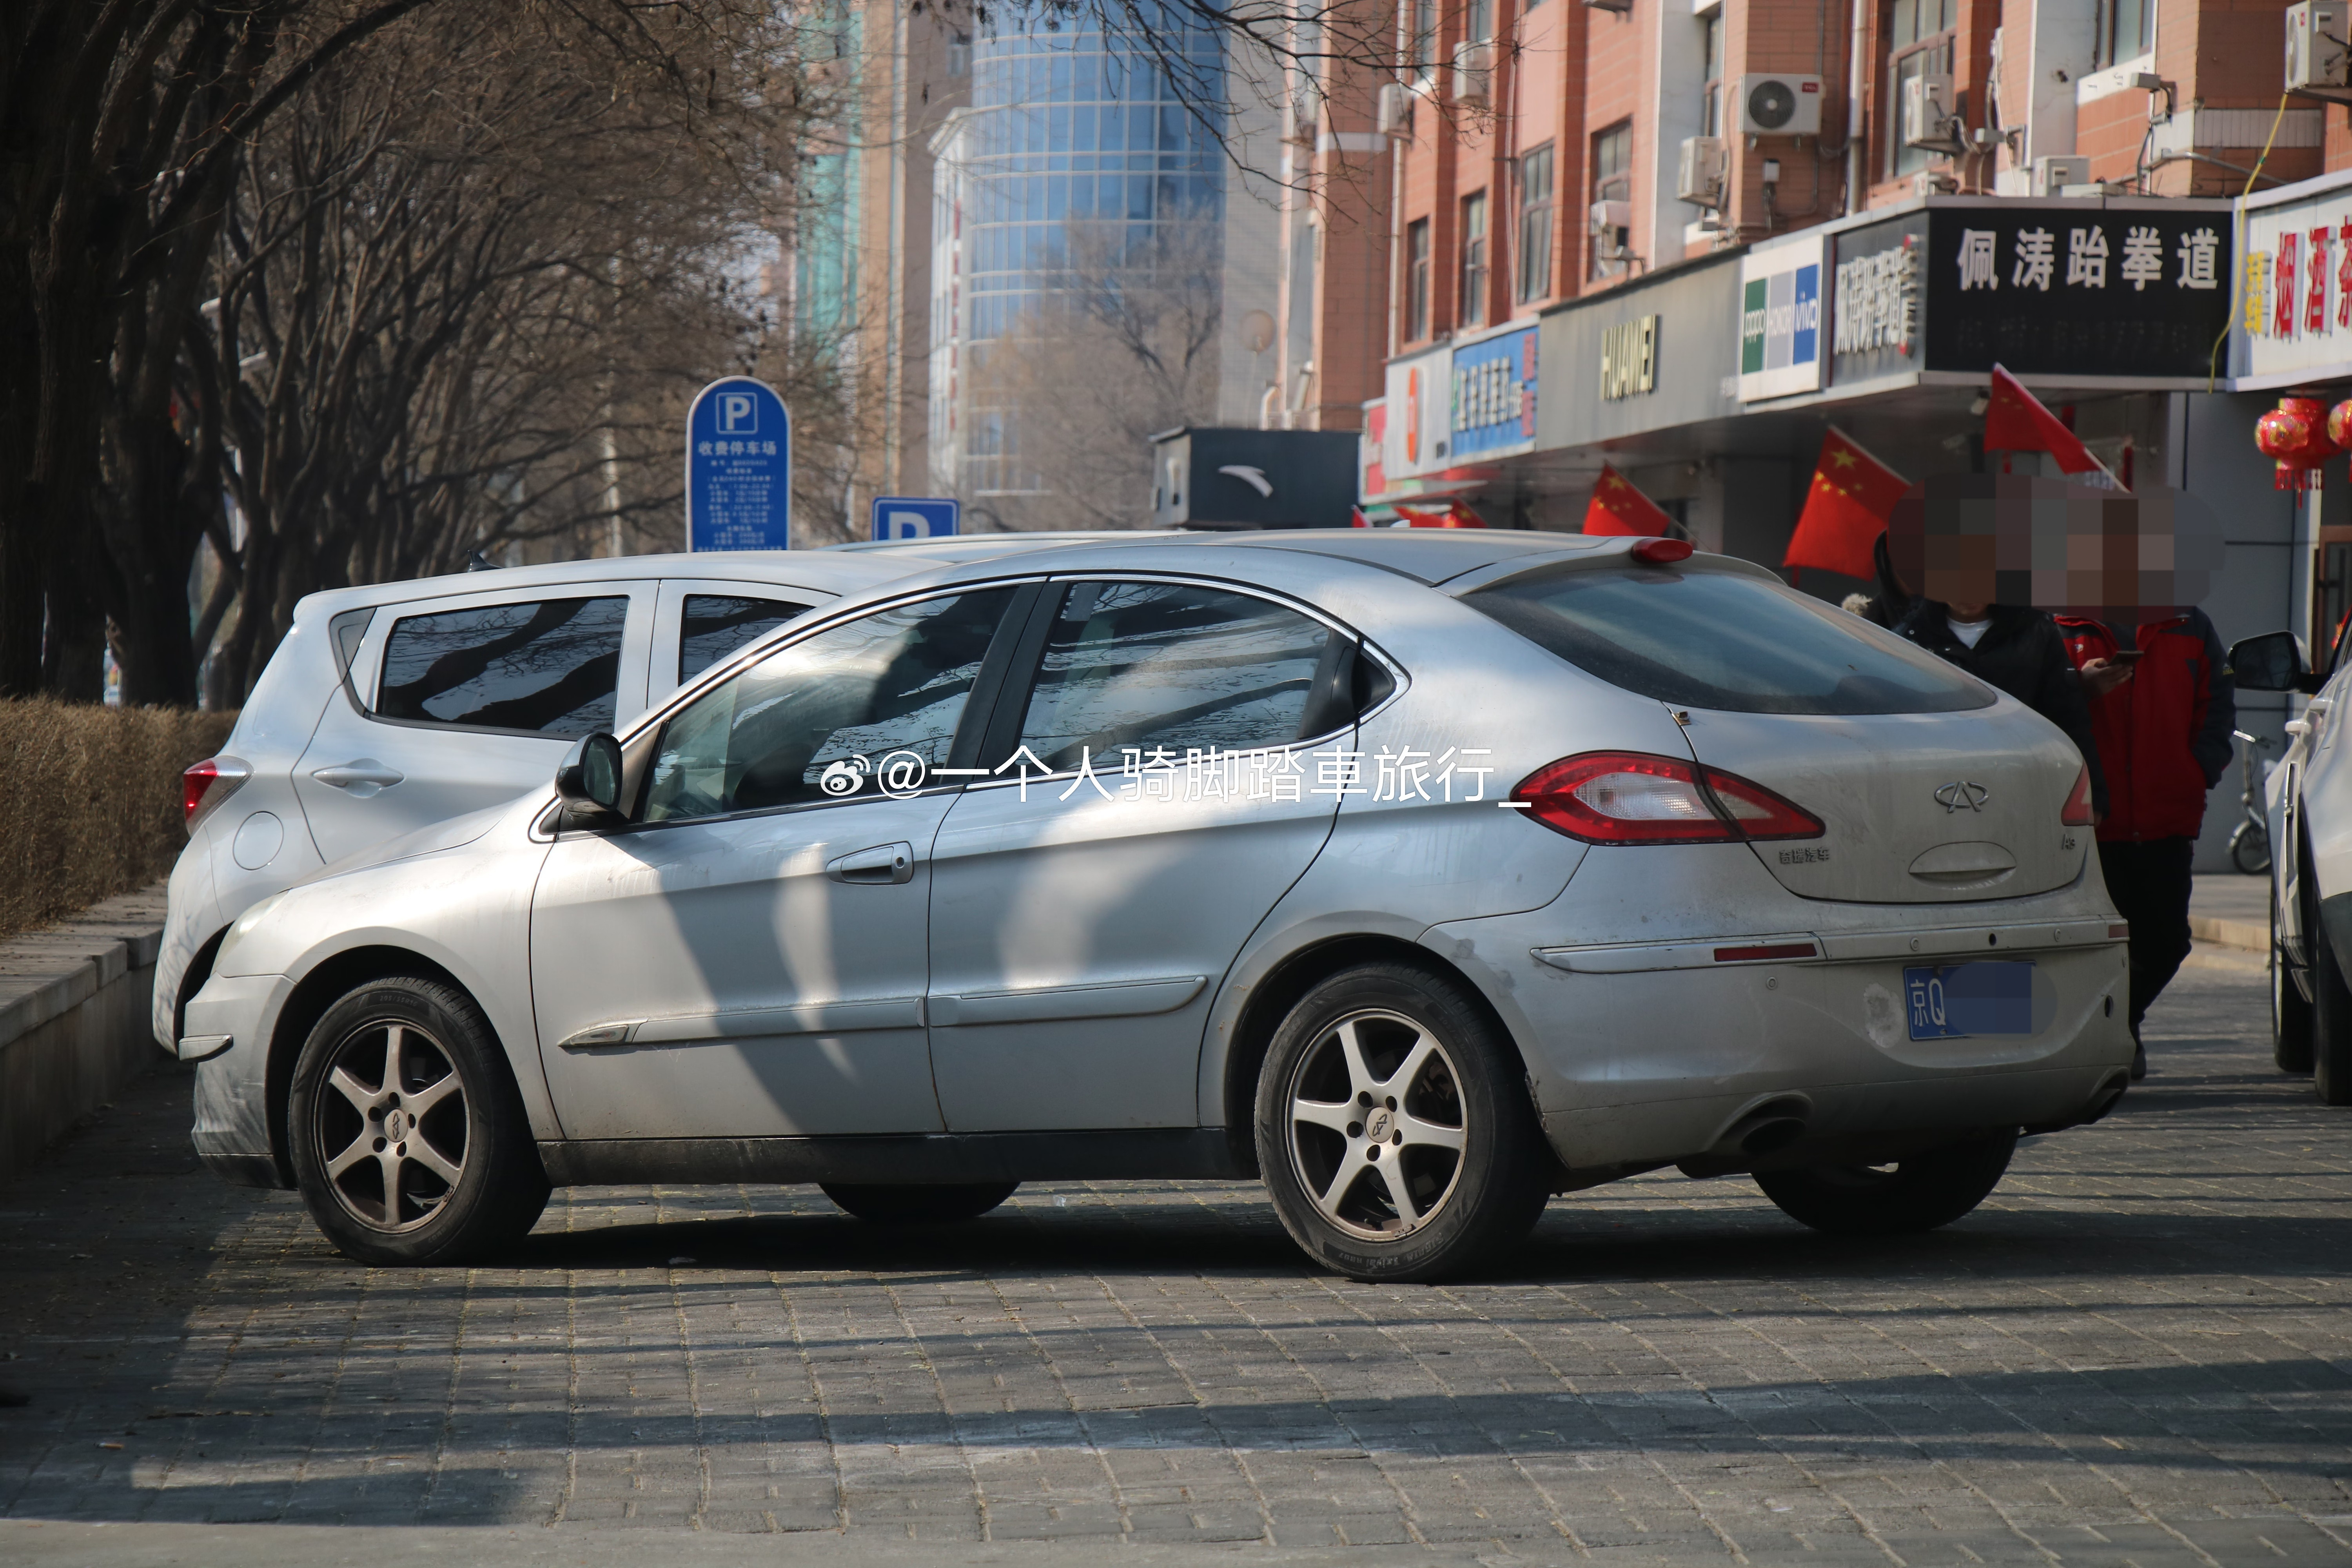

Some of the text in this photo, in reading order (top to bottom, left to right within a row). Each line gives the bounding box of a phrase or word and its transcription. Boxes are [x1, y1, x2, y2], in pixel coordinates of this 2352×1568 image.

[1956, 225, 2219, 291] 佩涛跆拳道
[1795, 290, 1818, 332] vivo
[1601, 314, 1656, 401] HUAWEI
[726, 396, 750, 430] P
[698, 440, 777, 456] 收费停车场
[889, 511, 930, 539] P
[1779, 847, 1830, 864] 奇瑞汽车
[1910, 978, 1946, 1027] 京Q
